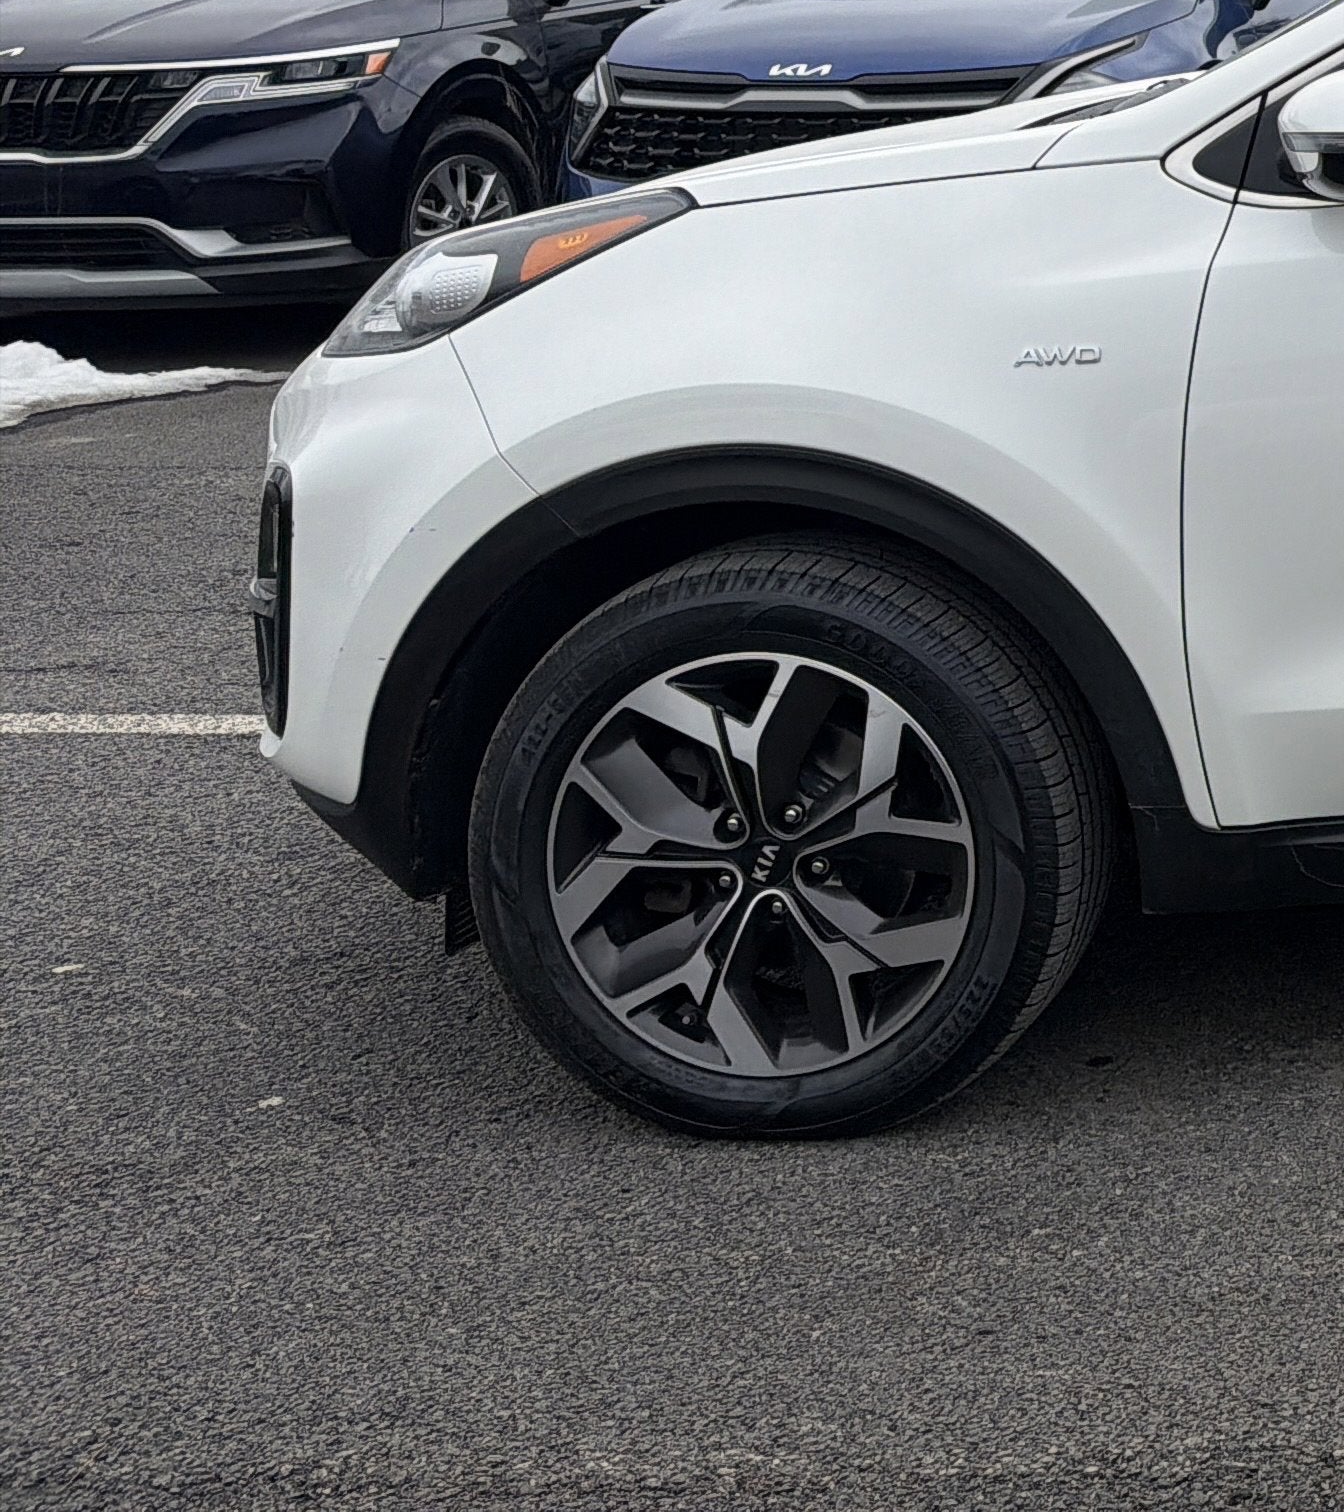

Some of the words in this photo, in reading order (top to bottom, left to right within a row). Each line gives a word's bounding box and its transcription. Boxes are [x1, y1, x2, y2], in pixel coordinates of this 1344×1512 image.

[768, 63, 833, 77] KIA
[1012, 344, 1103, 369] AWD
[751, 845, 781, 883] KIA
